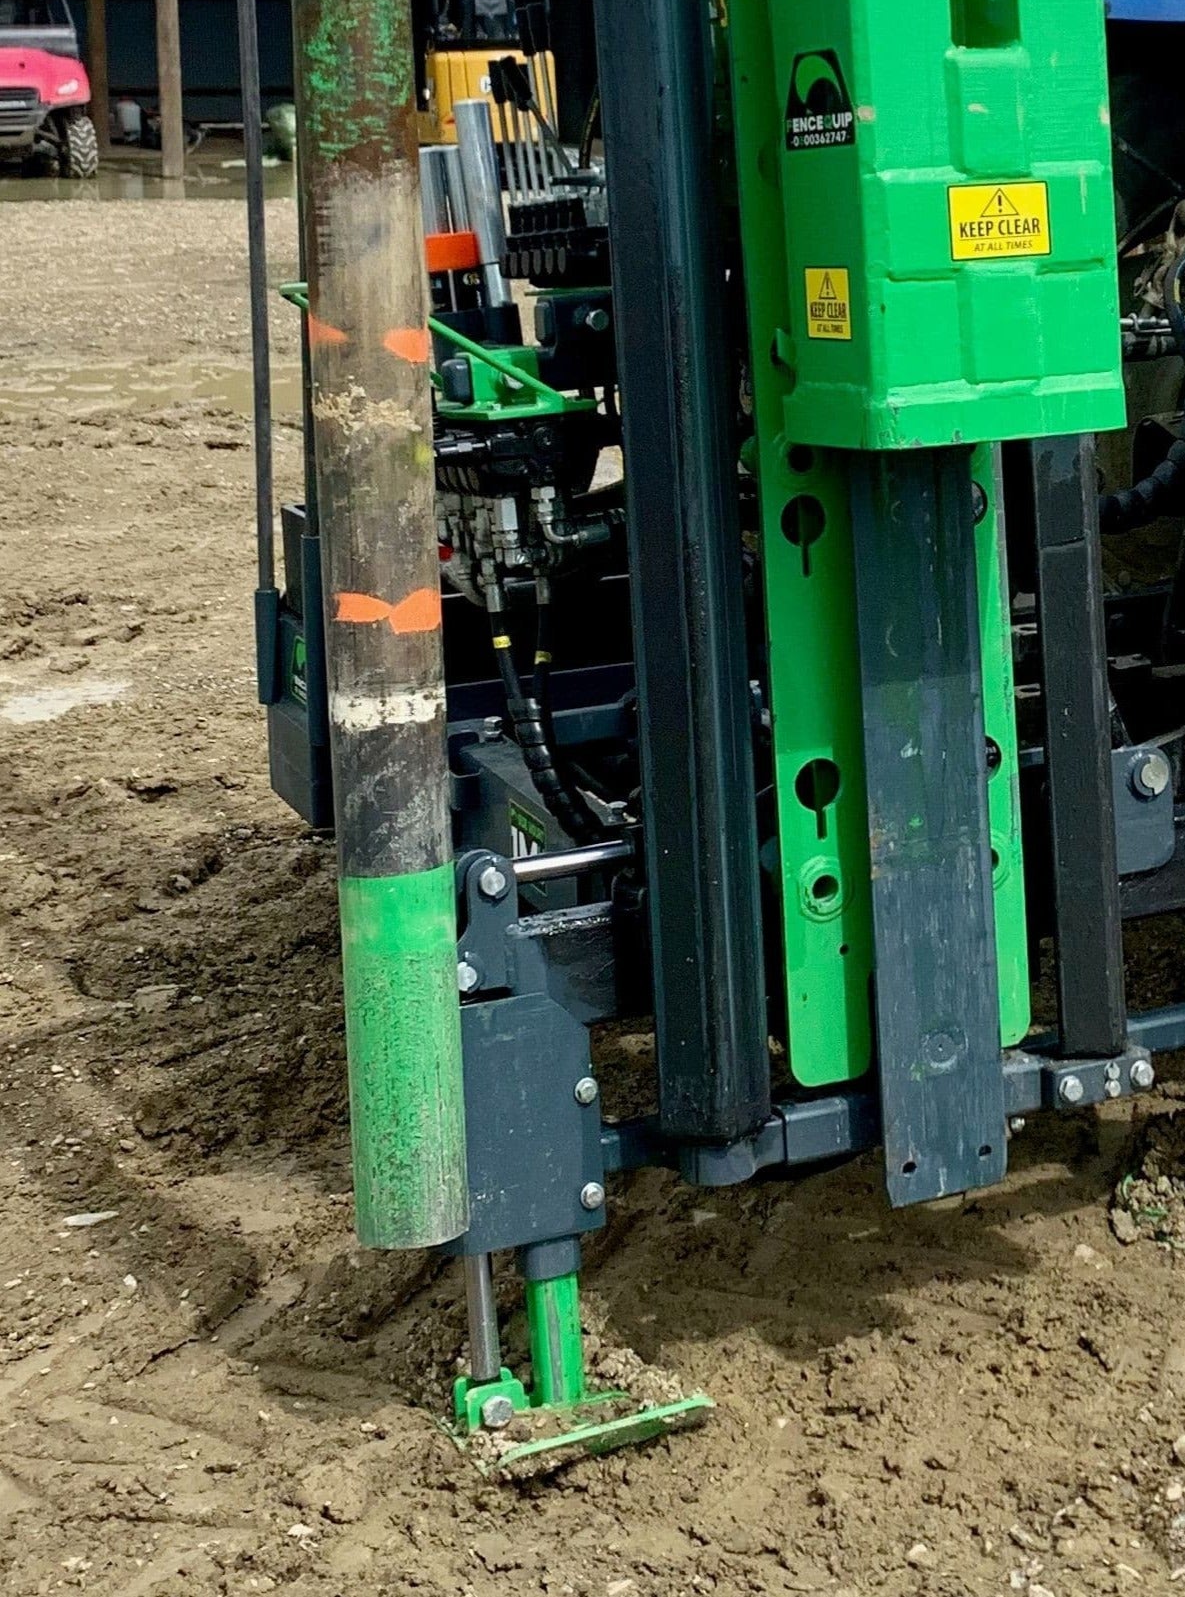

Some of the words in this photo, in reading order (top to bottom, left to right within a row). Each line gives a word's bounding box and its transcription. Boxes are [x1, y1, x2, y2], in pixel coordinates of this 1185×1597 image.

[959, 220, 994, 238] KEEP
[998, 217, 1041, 235] CLEAR
[974, 242, 985, 252] AT
[986, 241, 1003, 251] ALL
[1006, 239, 1033, 250] TIMES
